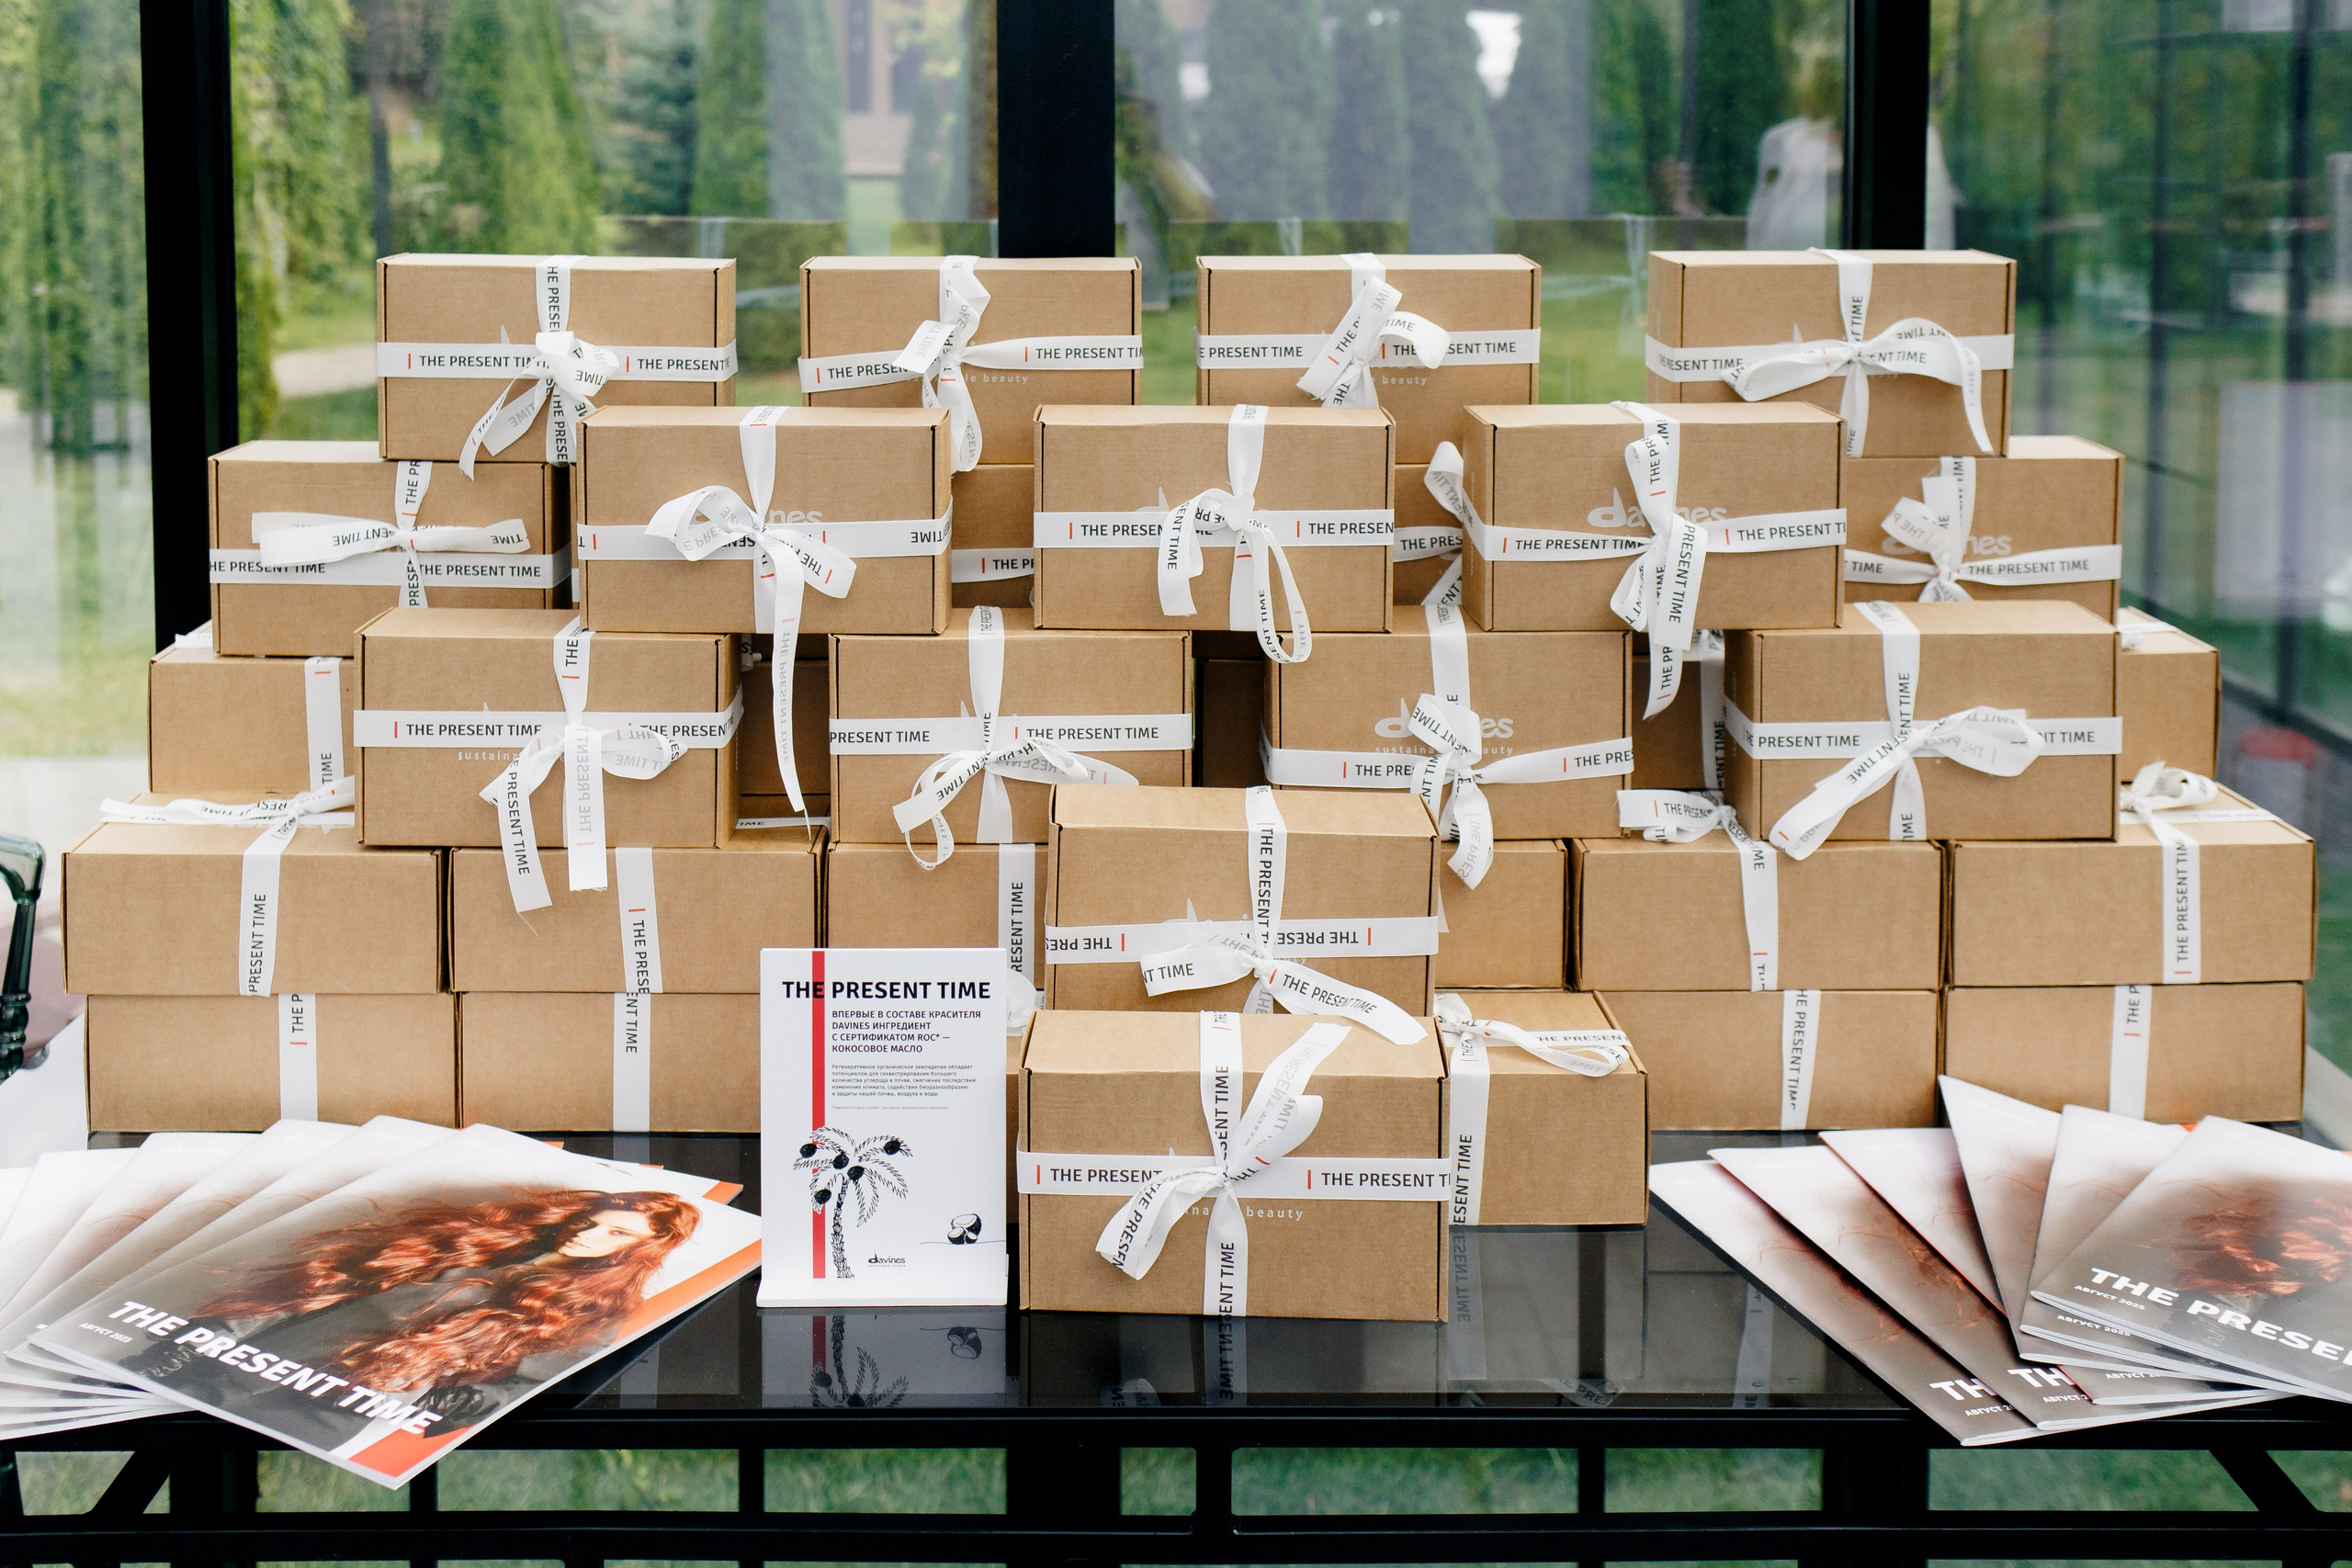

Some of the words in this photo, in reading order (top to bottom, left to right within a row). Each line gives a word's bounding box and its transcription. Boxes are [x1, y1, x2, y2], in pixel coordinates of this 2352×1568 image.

[1852, 296, 1862, 327] TIME
[1385, 319, 1416, 332] TIME
[1335, 331, 1357, 353] THE
[1486, 342, 1517, 355] TIME
[1035, 347, 1061, 360] THE
[1065, 347, 1125, 359] PRESENT
[1209, 345, 1269, 358] PRESENT
[1272, 345, 1304, 357] TIME
[1896, 351, 1927, 364] TIME
[419, 355, 447, 367] THE
[448, 355, 512, 368] PRESENT
[637, 357, 664, 370] THE
[666, 358, 728, 371] PRESENT
[1712, 356, 1744, 370] TIME
[827, 367, 854, 380] THE
[982, 373, 1029, 385] beauty
[1382, 375, 1428, 386] beauty
[1649, 458, 1661, 485] THE
[405, 481, 419, 505] THE
[910, 531, 943, 544] TIME
[1080, 524, 1109, 536] THE
[1308, 523, 1338, 535] THE
[1737, 528, 1767, 542] THE
[1770, 524, 1832, 539] PRESENT
[332, 534, 361, 547] TIME
[1400, 537, 1427, 551] THE
[1430, 536, 1463, 548] PRES
[1515, 538, 1544, 551] THE
[1544, 538, 1611, 550] PRESENT
[1167, 536, 1180, 570] TIME
[1677, 523, 1696, 591] PRESENT
[419, 564, 443, 576] THE
[446, 565, 506, 577] PRESENT
[509, 567, 542, 578] TIME
[800, 553, 823, 577] THE
[992, 558, 1019, 570] THE
[1852, 561, 1884, 575] TIME
[1968, 565, 1995, 576] THE
[1997, 561, 2056, 575] PRESENT
[2059, 558, 2090, 572] TIME
[1668, 585, 1686, 625] TIME
[565, 638, 579, 668] THE
[1660, 663, 1673, 691] THE
[1898, 671, 1911, 702] TIME
[1412, 706, 1442, 734] TIME
[405, 724, 435, 737] THE
[437, 724, 503, 737] PRESENT
[830, 730, 894, 744] PRESENT
[896, 730, 931, 743] TIME
[1026, 728, 1055, 740] THE
[1057, 726, 1122, 740] PRESENT
[1125, 726, 1159, 739] TIME
[2064, 730, 2097, 744] TIME
[1758, 735, 1824, 748] PRESENT
[1826, 734, 1860, 747] TIME
[322, 751, 333, 784] TIME
[1575, 754, 1602, 768] THE
[1354, 764, 1384, 777] THE
[1847, 756, 1877, 785] TIME
[936, 775, 966, 803] TIME
[506, 771, 524, 838] PRESENT
[1664, 803, 1683, 816] THE
[1259, 828, 1274, 855] THE
[513, 840, 530, 875] TIME
[1012, 881, 1025, 916] TIME
[1257, 860, 1273, 929] PRESENT
[2176, 867, 2189, 933] PRESENT
[253, 893, 266, 933] TIME
[632, 919, 647, 948] THE
[1329, 931, 1360, 945] THE
[1082, 936, 1113, 951] THE
[2176, 936, 2189, 963] THE
[247, 934, 264, 994] PRESENT
[1158, 963, 1195, 983] TIME
[782, 981, 825, 999] THE
[831, 981, 932, 999] PRESENT
[937, 981, 991, 999] TIME
[1281, 973, 1310, 996] THE
[291, 1007, 304, 1034] THE
[831, 1010, 876, 1019] ВПЕРВЫЕ
[877, 1010, 884, 1019] В
[886, 1010, 926, 1019] СОСТАВЕ
[929, 1010, 981, 1019] КРАСИТЕЛЯ
[2126, 999, 2140, 1024] THE
[831, 1021, 870, 1030] DAVINES
[873, 1021, 932, 1032] ИНГРЕДИЕНТ
[626, 1021, 638, 1054] TIME
[831, 1033, 838, 1042] С
[840, 1032, 915, 1042] СЕРТИФИКАТОМ
[831, 1044, 888, 1053] КОКОСОВОЕ
[890, 1044, 923, 1053] МАСЛО
[1792, 1011, 1807, 1083] PRESENT
[1215, 1066, 1229, 1106] TIME
[1456, 1134, 1473, 1172] TIME
[1050, 1168, 1082, 1183] THE
[1321, 1171, 1355, 1187] THE
[1358, 1172, 1435, 1188] PRESENT
[1246, 1206, 1305, 1222] beauty
[867, 1252, 906, 1264] davines
[1219, 1242, 1235, 1279] TIME
[2074, 1284, 2118, 1301] АВГУСТ
[2118, 1298, 2146, 1311] 2025
[2056, 1314, 2102, 1330] АВГУСТ
[2090, 1267, 2180, 1307] THE
[2187, 1299, 2352, 1366] PRESE
[77, 1322, 113, 1337] АВГУСТ
[112, 1331, 134, 1345] 2025
[107, 1301, 188, 1337] THE
[174, 1325, 350, 1400] PRESENT
[337, 1385, 444, 1436] TIME
[2007, 1367, 2076, 1388] TH
[1928, 1378, 1998, 1401] TH
[2042, 1394, 2082, 1404] АВГУСТ
[1964, 1405, 2006, 1417] АВГУСТ
